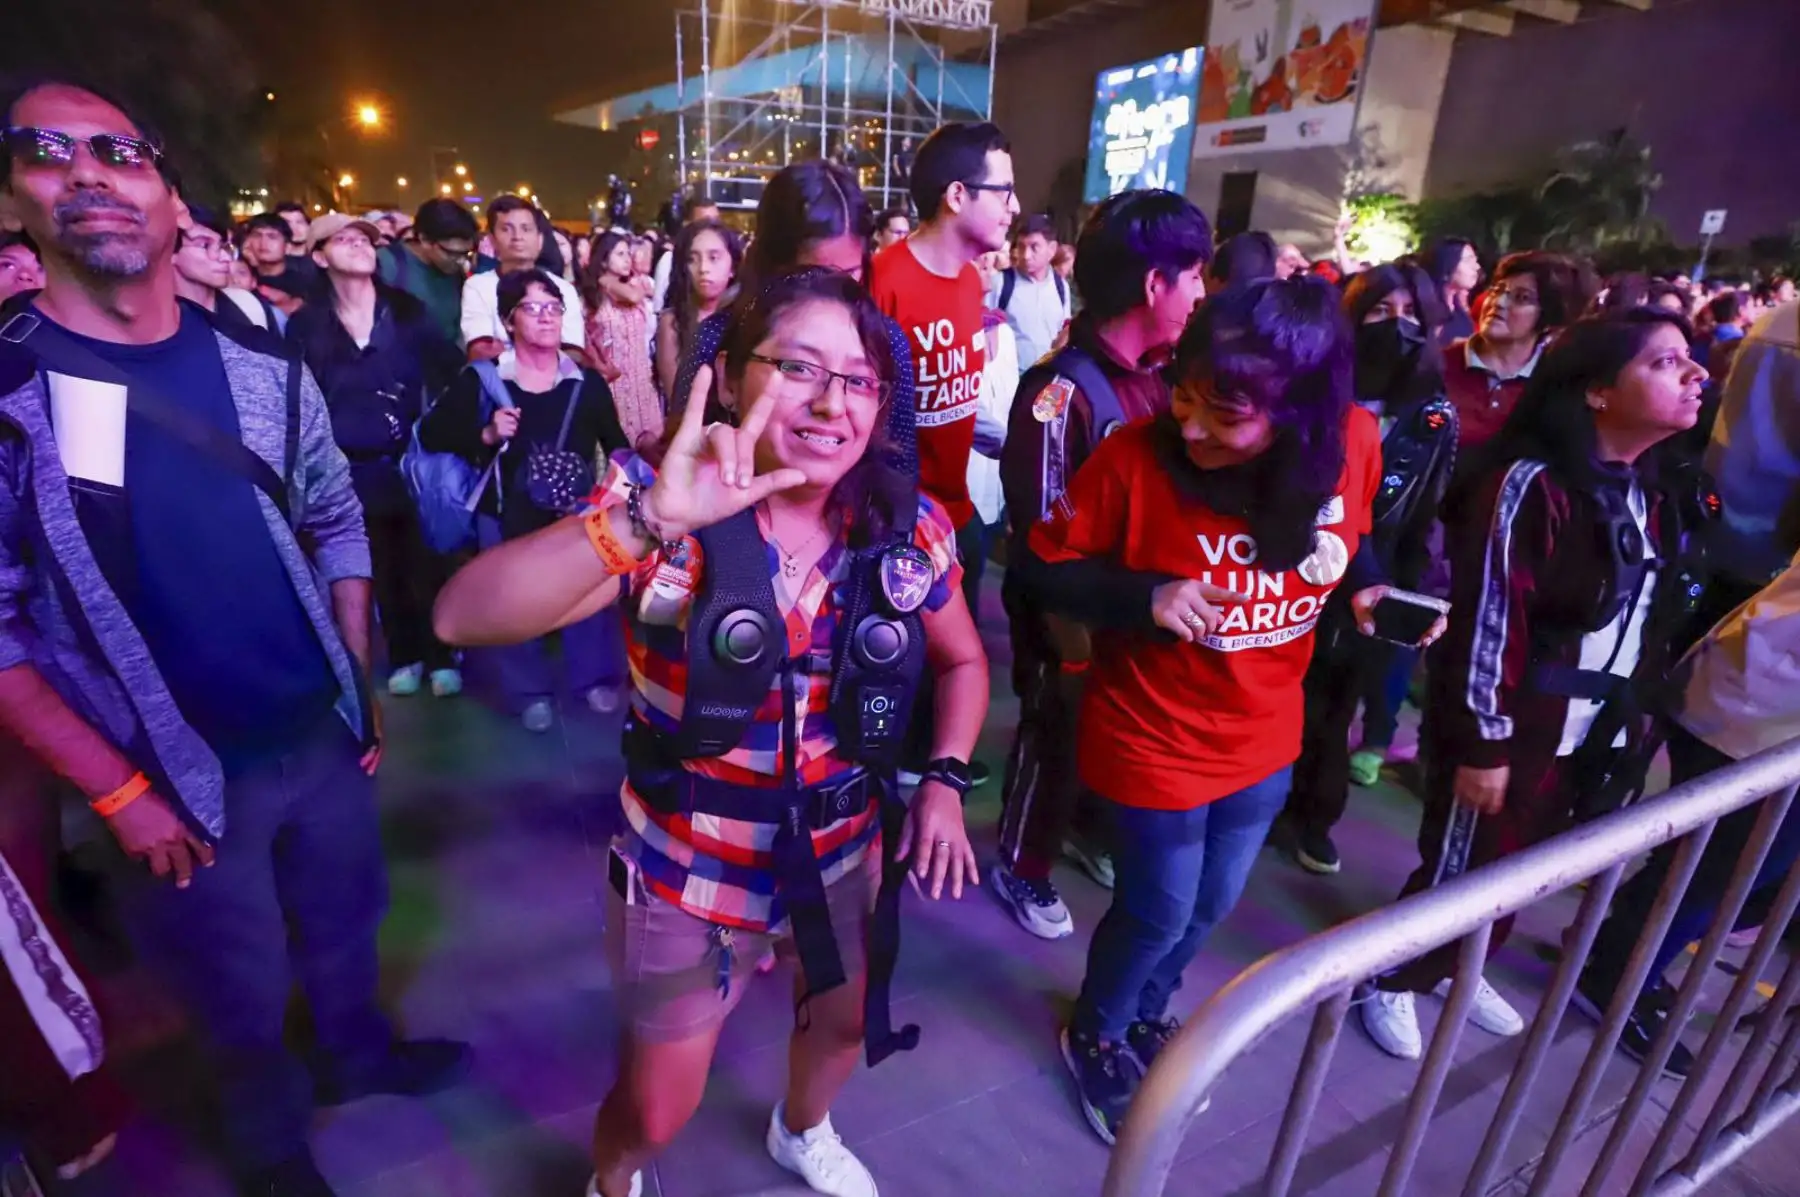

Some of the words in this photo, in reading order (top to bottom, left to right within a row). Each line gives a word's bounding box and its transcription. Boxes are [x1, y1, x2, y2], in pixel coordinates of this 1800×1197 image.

[912, 318, 954, 352] VO
[919, 345, 966, 382] LUN
[915, 414, 937, 425] DEL
[1196, 533, 1258, 566] VO
[1210, 588, 1334, 633] ARIOS
[701, 705, 748, 719] woojer
